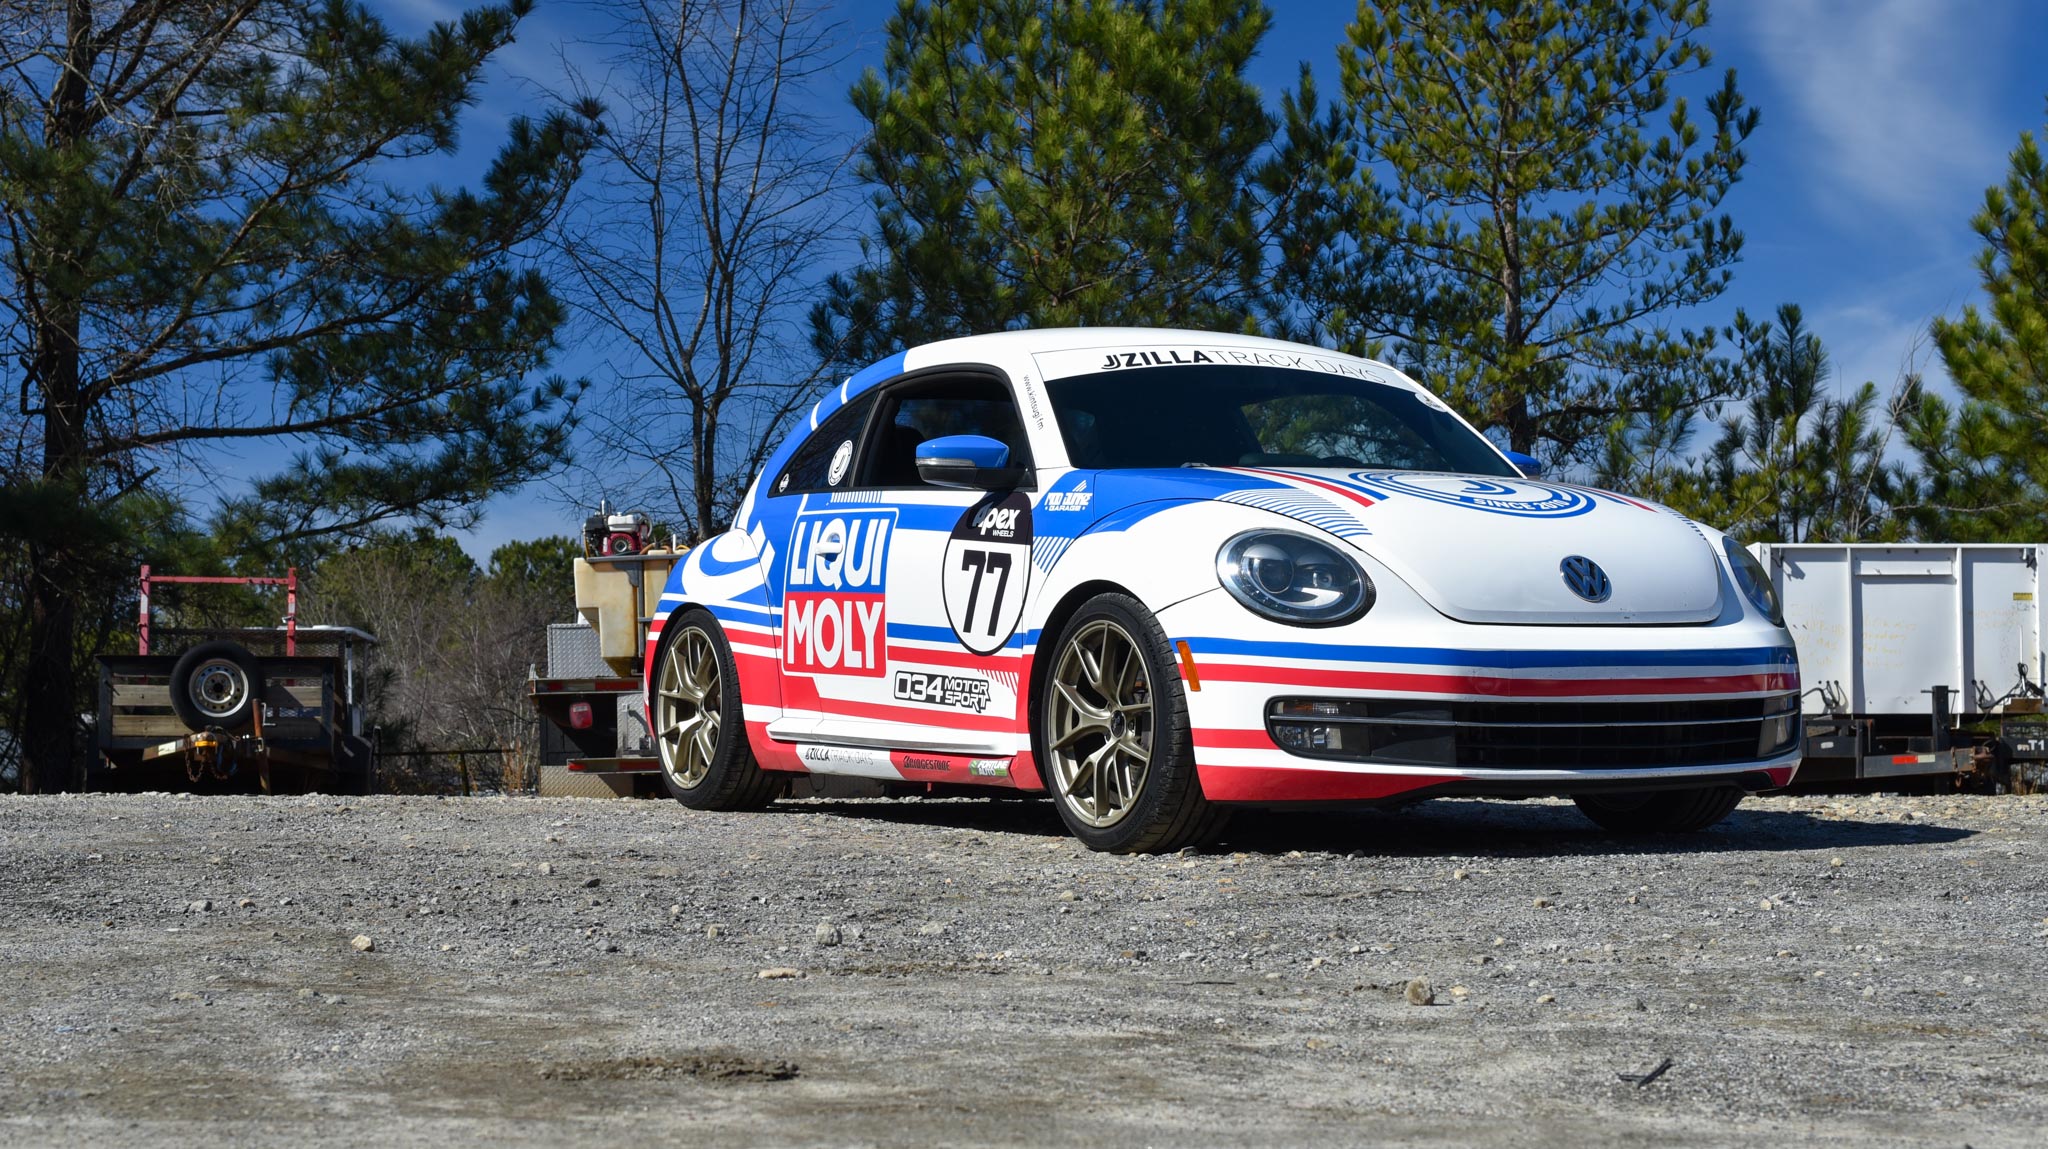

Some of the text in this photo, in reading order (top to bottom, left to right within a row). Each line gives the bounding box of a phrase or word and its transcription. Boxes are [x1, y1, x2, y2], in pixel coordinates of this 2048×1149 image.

[1207, 351, 1313, 370] TRACK
[1315, 359, 1386, 384] DAYS
[1473, 498, 1536, 510] SINCE
[992, 529, 1015, 538] WHEELS
[790, 517, 890, 590] LIQUI
[961, 549, 1012, 637] 77
[787, 598, 884, 669] MOLY
[895, 672, 944, 703] 034
[944, 678, 988, 699] MOTOR
[944, 690, 987, 713] SPORT
